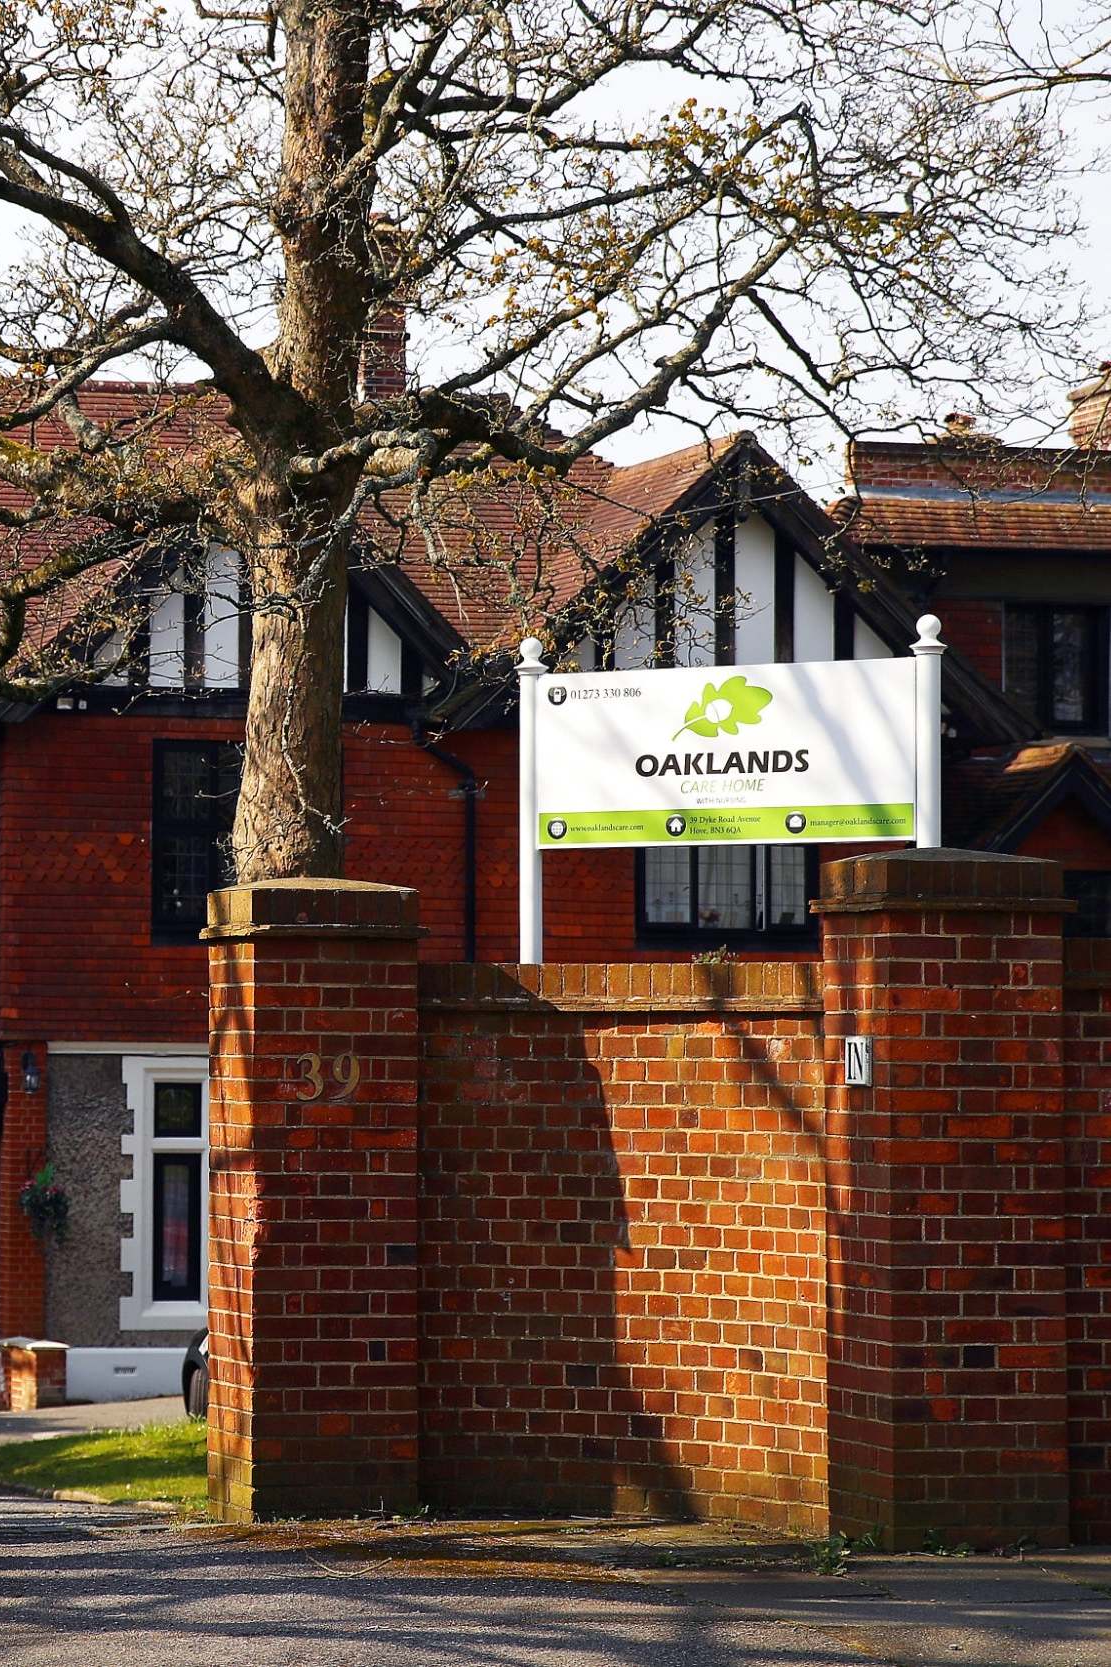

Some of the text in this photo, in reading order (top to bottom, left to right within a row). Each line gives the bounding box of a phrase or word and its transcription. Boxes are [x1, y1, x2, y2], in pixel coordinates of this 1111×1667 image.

[570, 687, 642, 700] 01273 330 806
[635, 749, 810, 778] OAKLANDS
[680, 778, 766, 794] CARE HOME
[689, 815, 761, 825] 39 Dyke Road Avenue
[710, 826, 725, 834] BN3
[725, 826, 742, 835] 6QA
[847, 1042, 864, 1080] IN
[296, 1052, 361, 1100] 39
